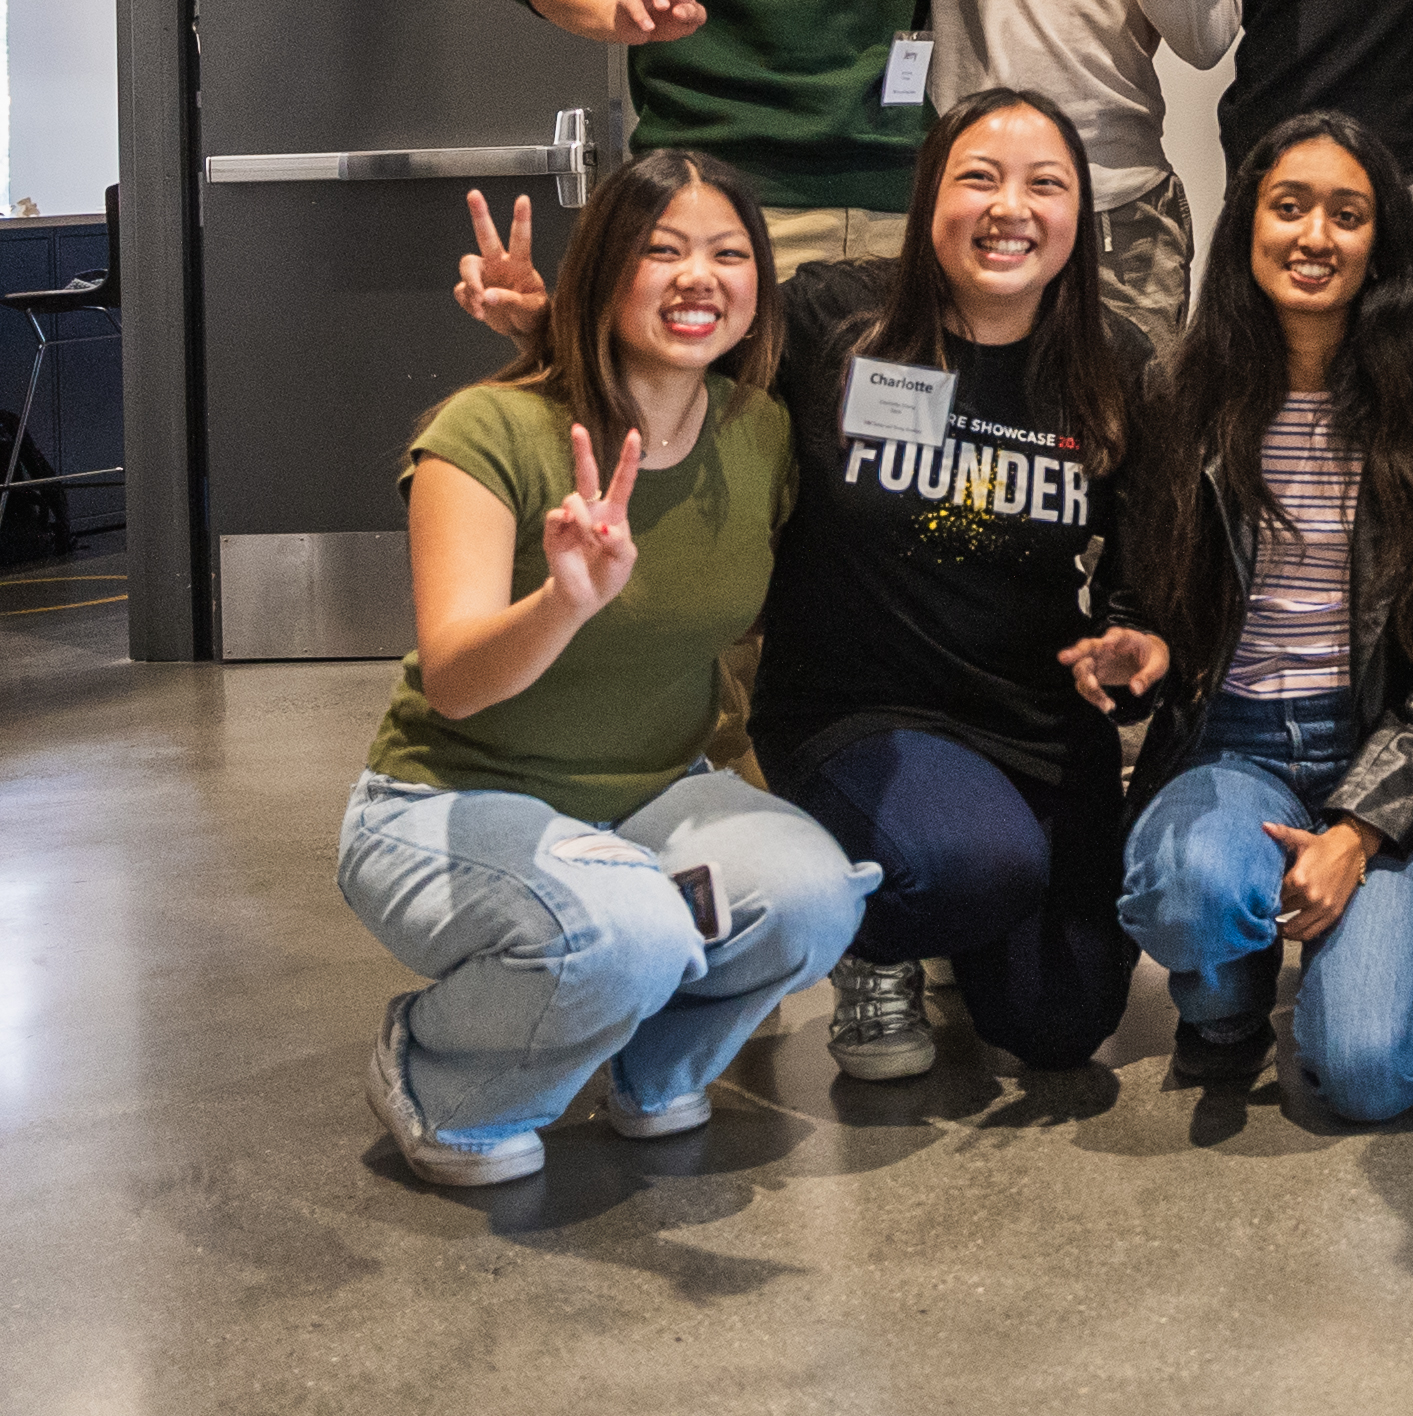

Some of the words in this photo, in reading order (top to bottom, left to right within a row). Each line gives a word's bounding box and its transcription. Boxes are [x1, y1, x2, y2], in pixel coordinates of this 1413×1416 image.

[869, 372, 934, 394] Charlotte
[970, 418, 1057, 448] SHOWCASE
[844, 437, 1090, 527] FOUNDER
